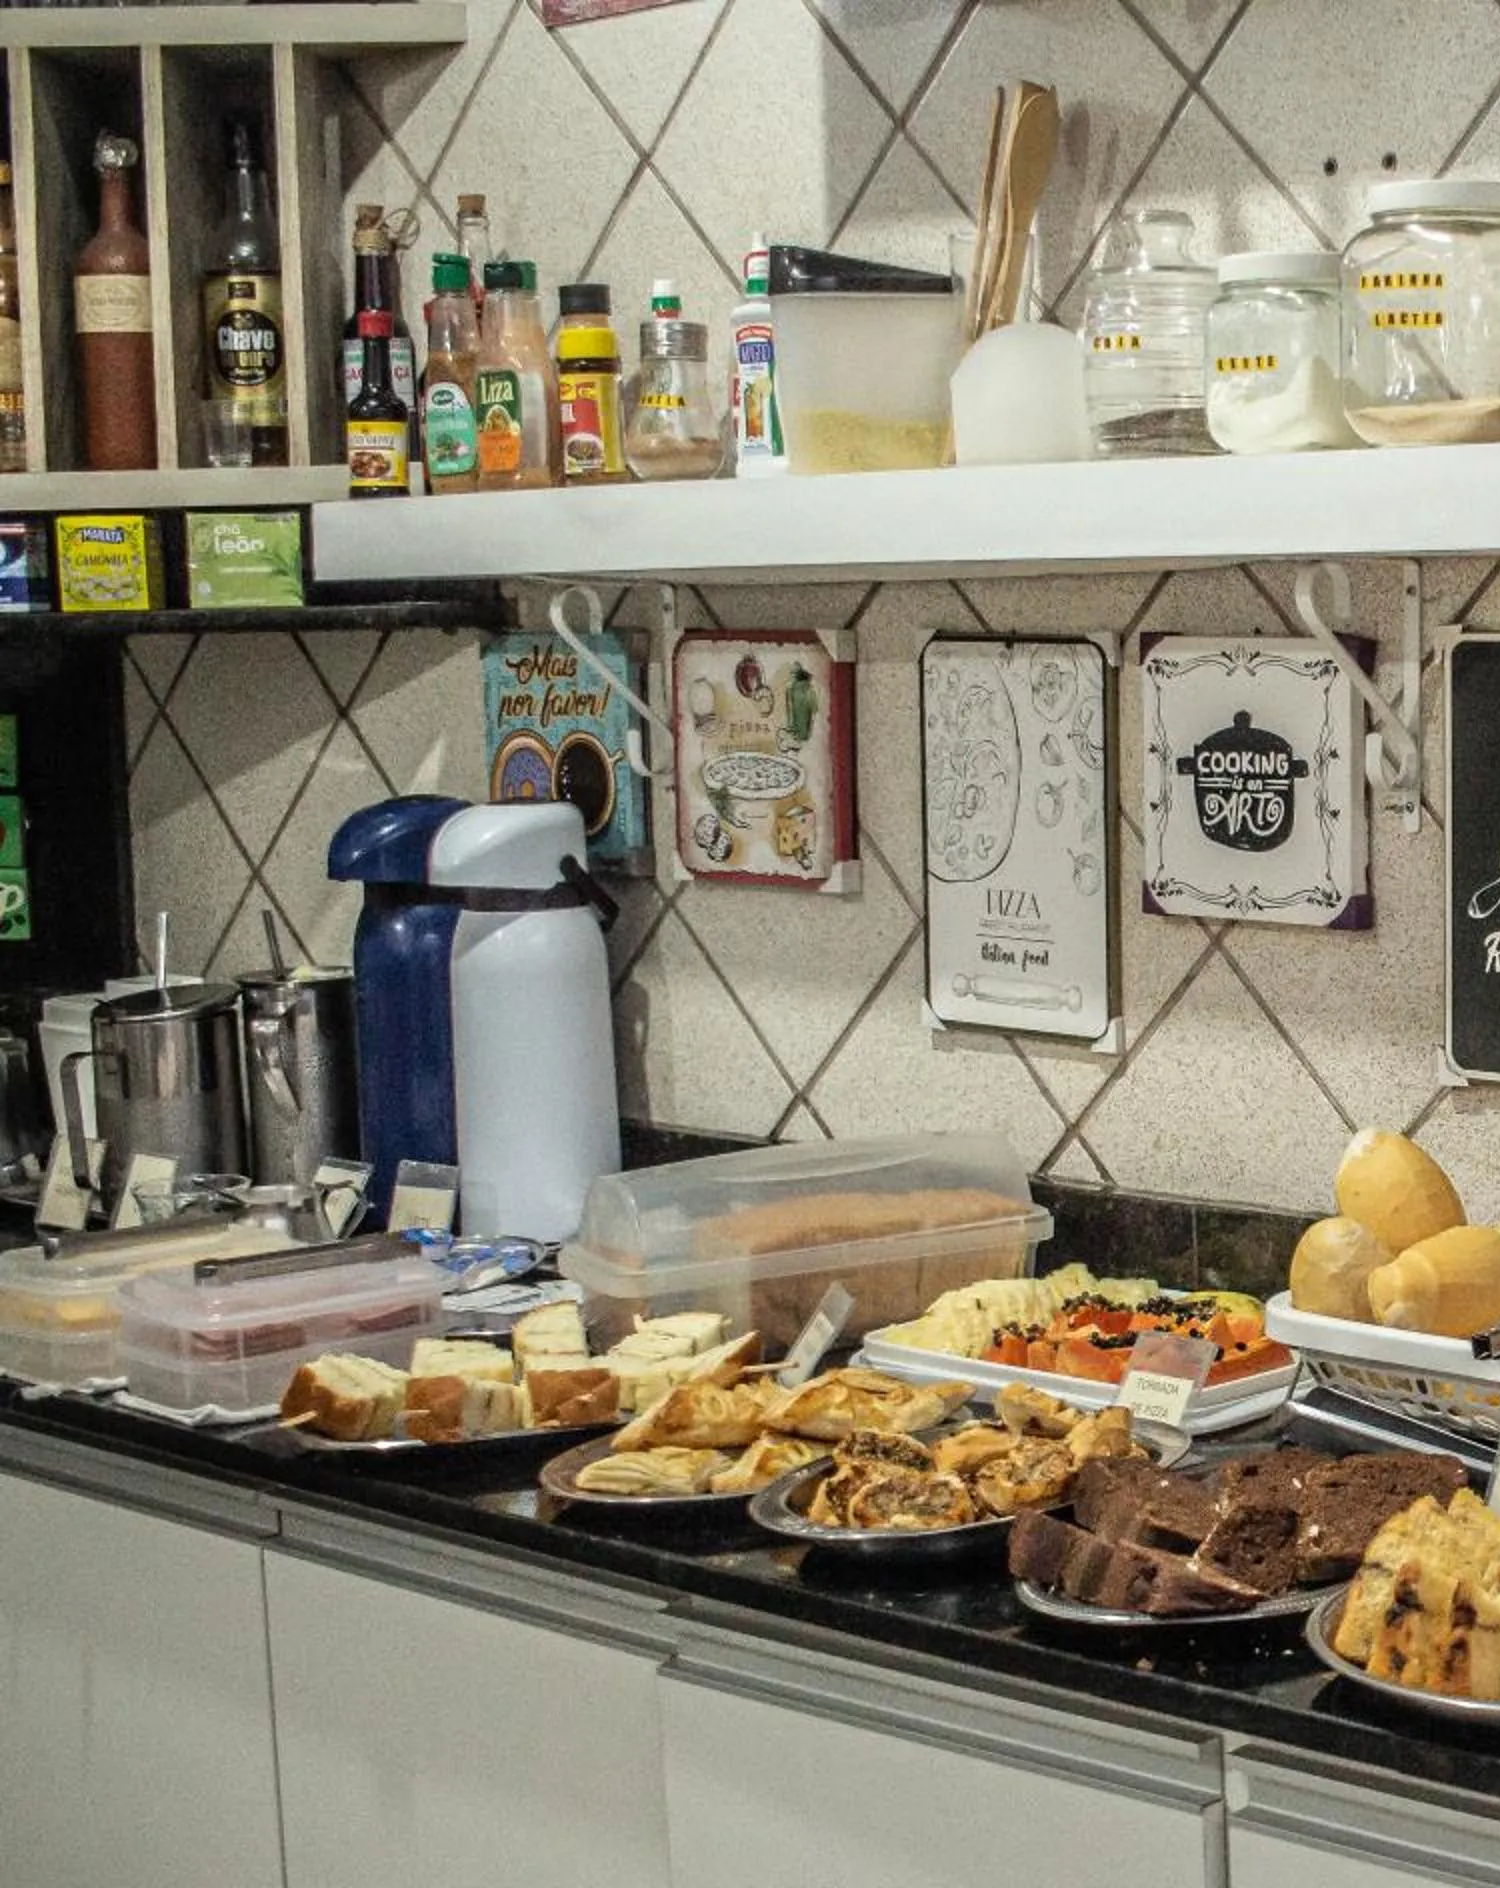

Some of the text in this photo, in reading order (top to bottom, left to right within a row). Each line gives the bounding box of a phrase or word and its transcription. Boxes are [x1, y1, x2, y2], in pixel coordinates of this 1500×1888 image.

[1361, 273, 1443, 289] FARINHA
[505, 643, 578, 685] Mais
[1197, 751, 1290, 777] COOKING
[1203, 791, 1286, 837] ART
